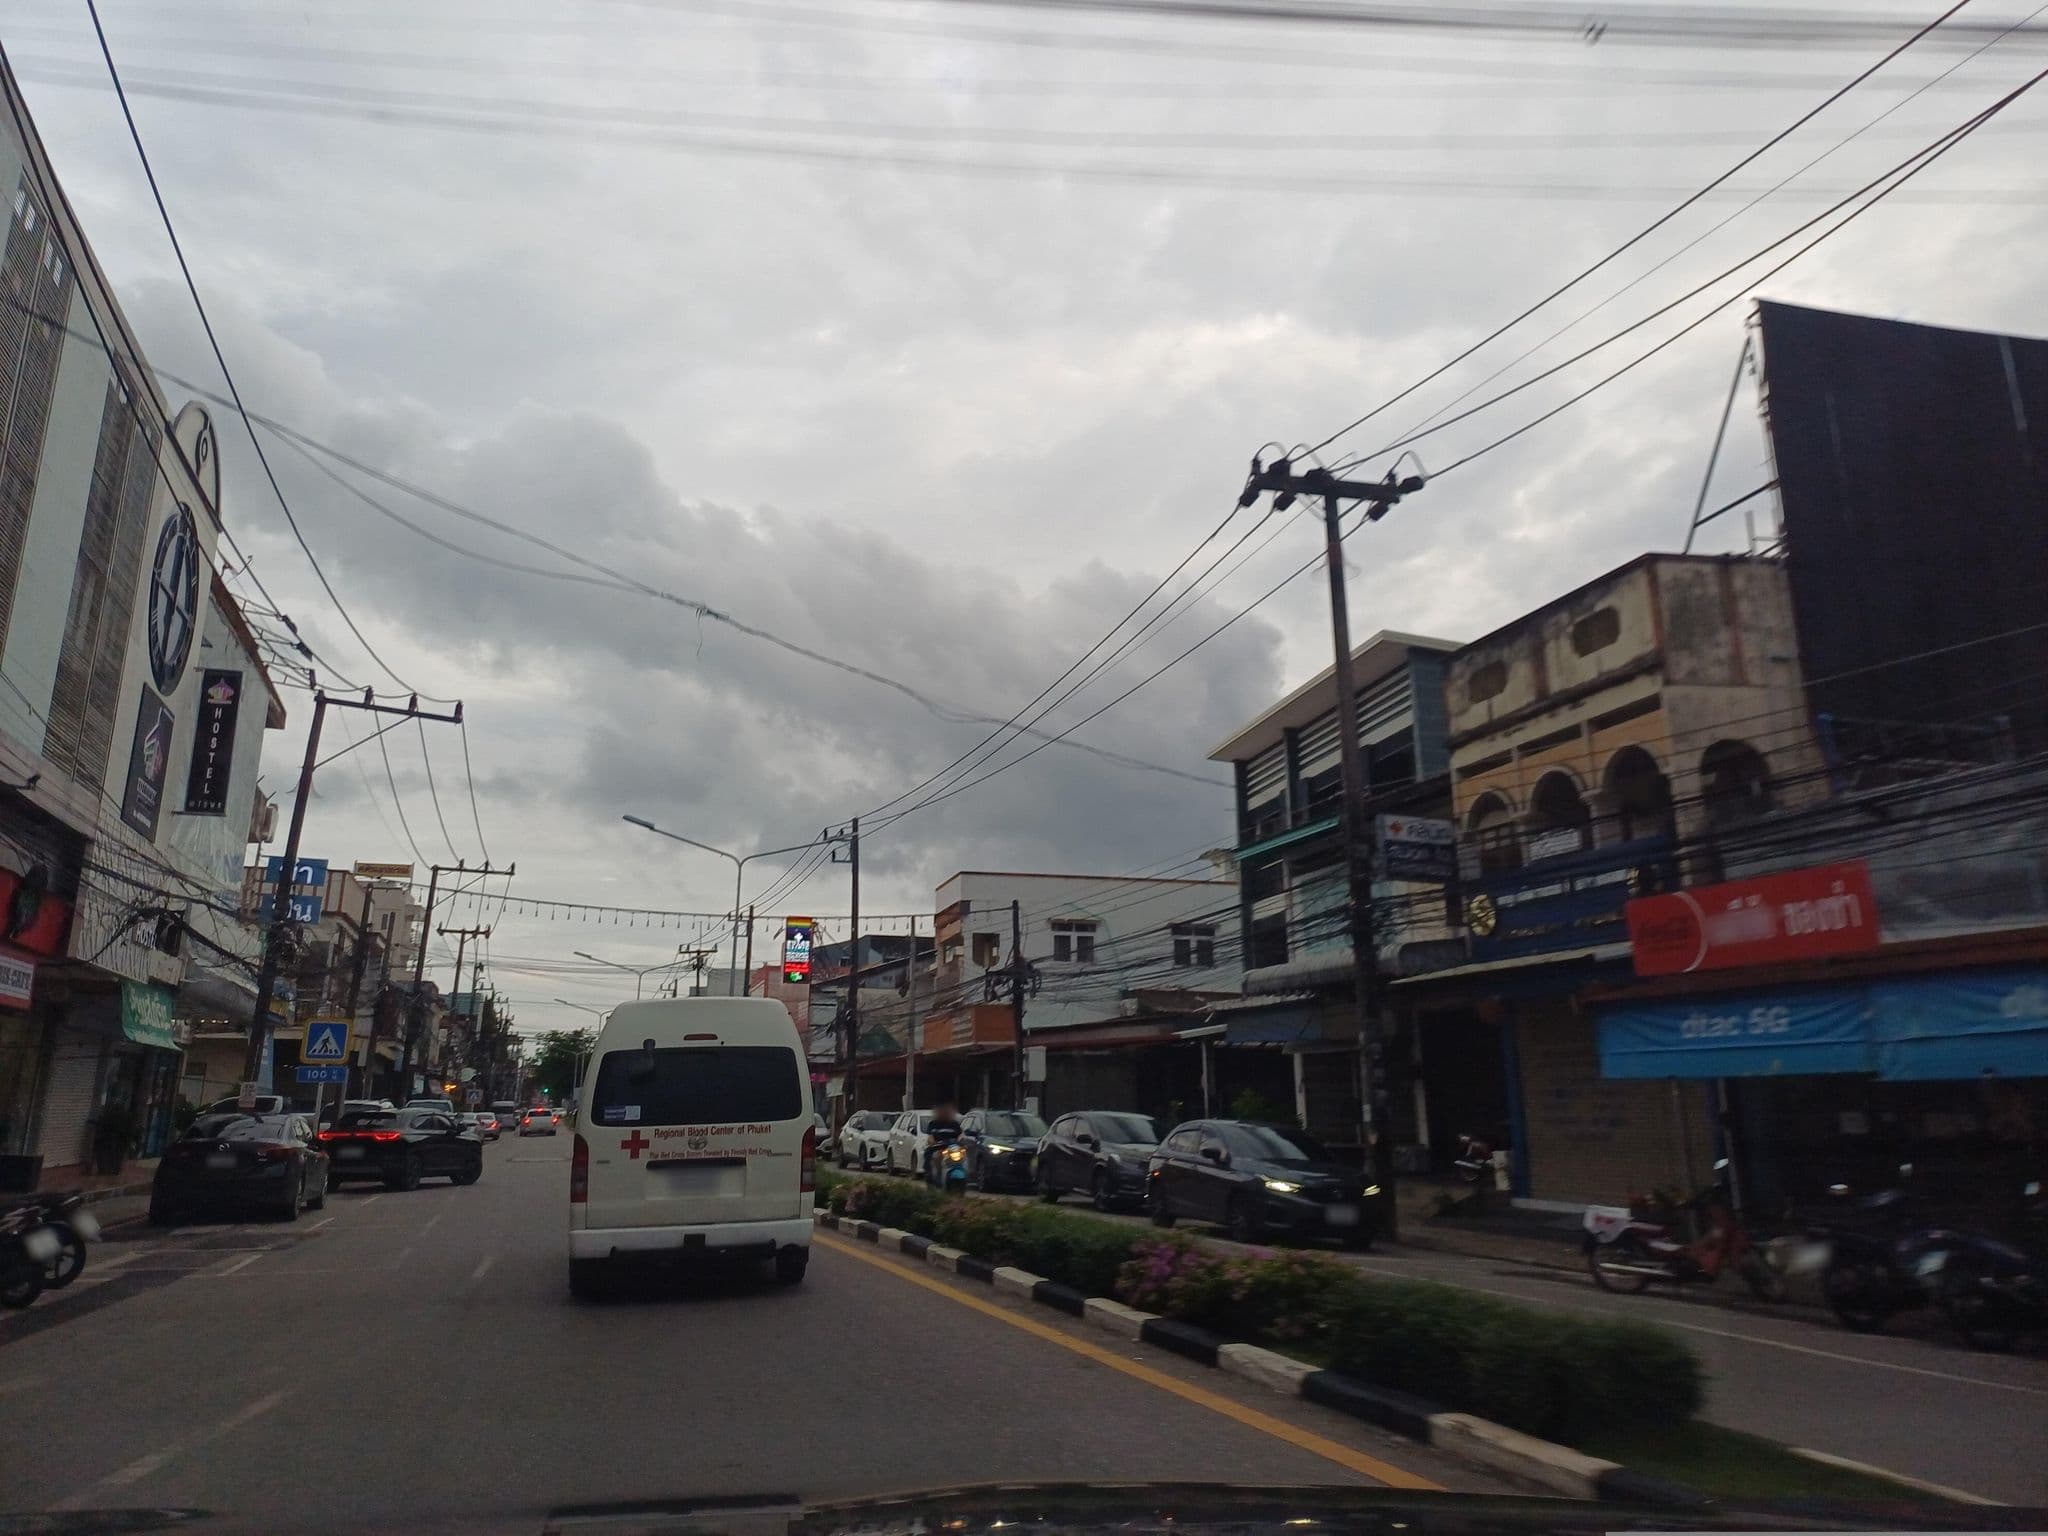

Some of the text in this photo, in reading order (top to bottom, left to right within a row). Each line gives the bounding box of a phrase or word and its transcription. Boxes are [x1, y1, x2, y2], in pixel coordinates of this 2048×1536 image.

[203, 706, 223, 795] HOSTEL
[1681, 1006, 1791, 1039] dtac 5G
[307, 1070, 328, 1079] 100
[654, 1123, 771, 1140] Regional Blood Center of Phuket
